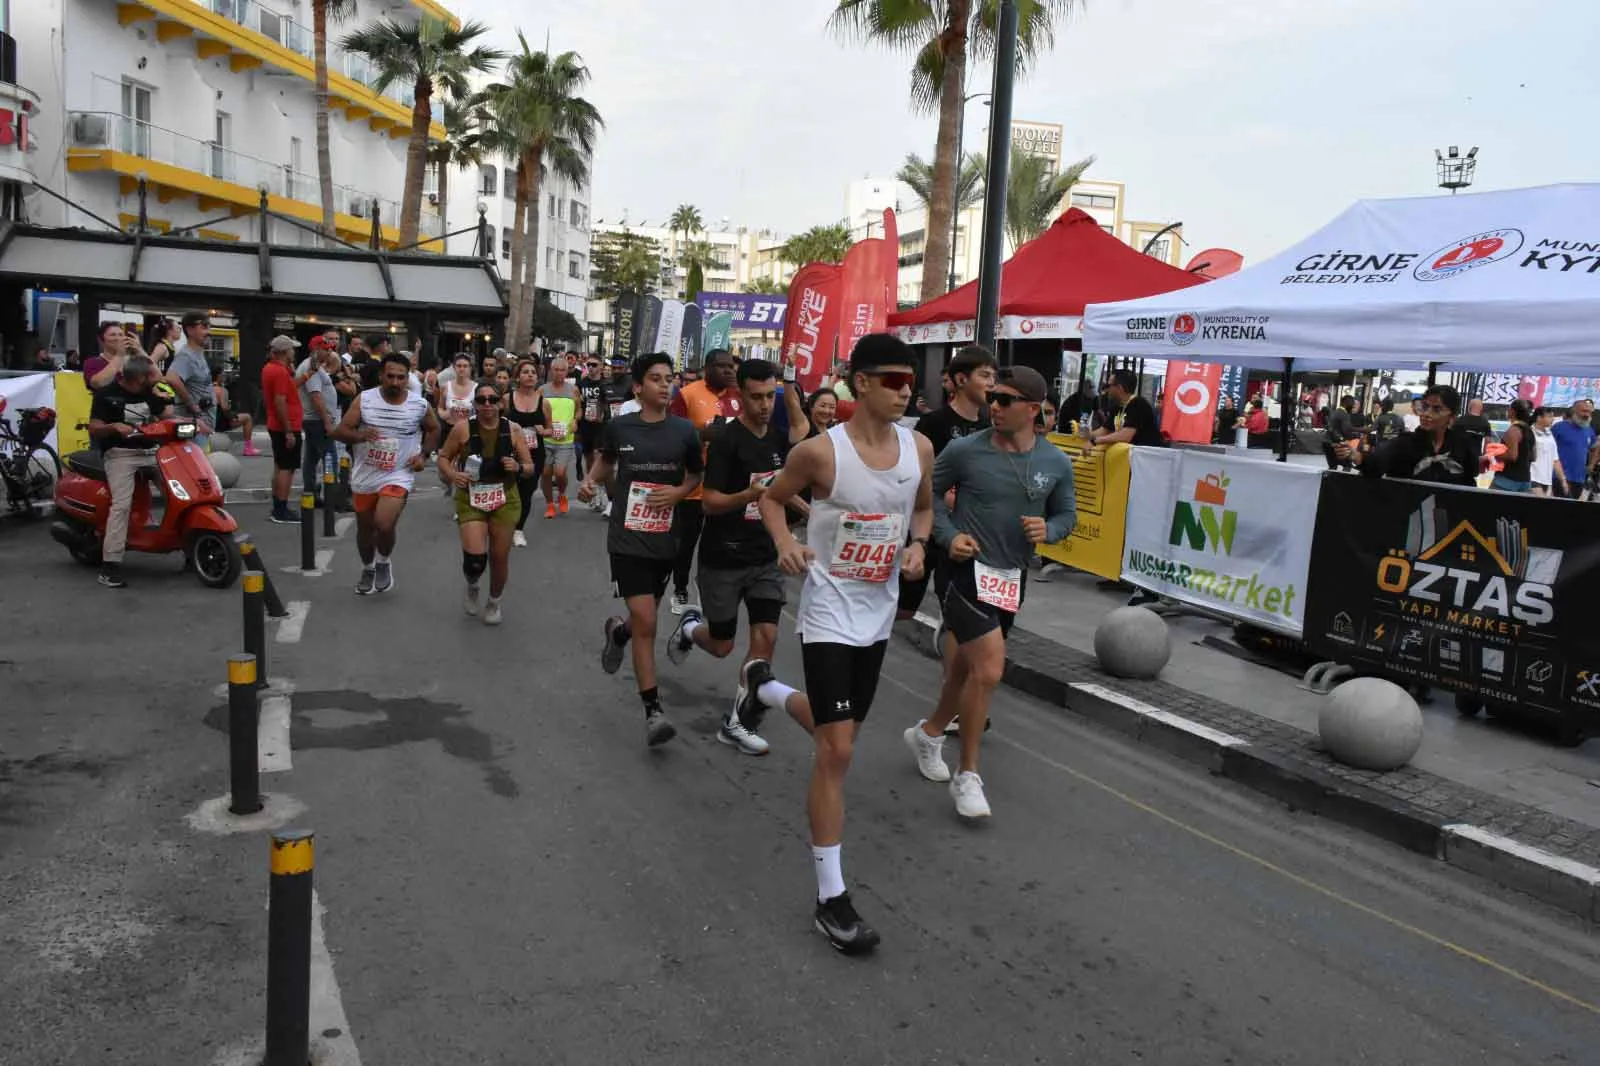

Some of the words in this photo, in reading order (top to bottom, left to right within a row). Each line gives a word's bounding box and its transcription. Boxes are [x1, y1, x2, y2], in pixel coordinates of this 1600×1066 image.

[1013, 127, 1059, 142] DOME
[1535, 237, 1600, 253] MUN
[1295, 249, 1418, 271] GİRNE
[1280, 271, 1401, 284] BELEDİYESİ
[797, 287, 813, 327] RADYO
[1203, 316, 1257, 324] MUNICIPALITY
[1259, 316, 1269, 324] OF
[797, 291, 827, 375] JUKE
[1202, 326, 1266, 340] KYRENIA
[980, 573, 1018, 598] 5248
[1376, 547, 1554, 627] ÖZTAŞ
[1400, 600, 1440, 619] YAPI
[1446, 609, 1521, 636] MARKET
